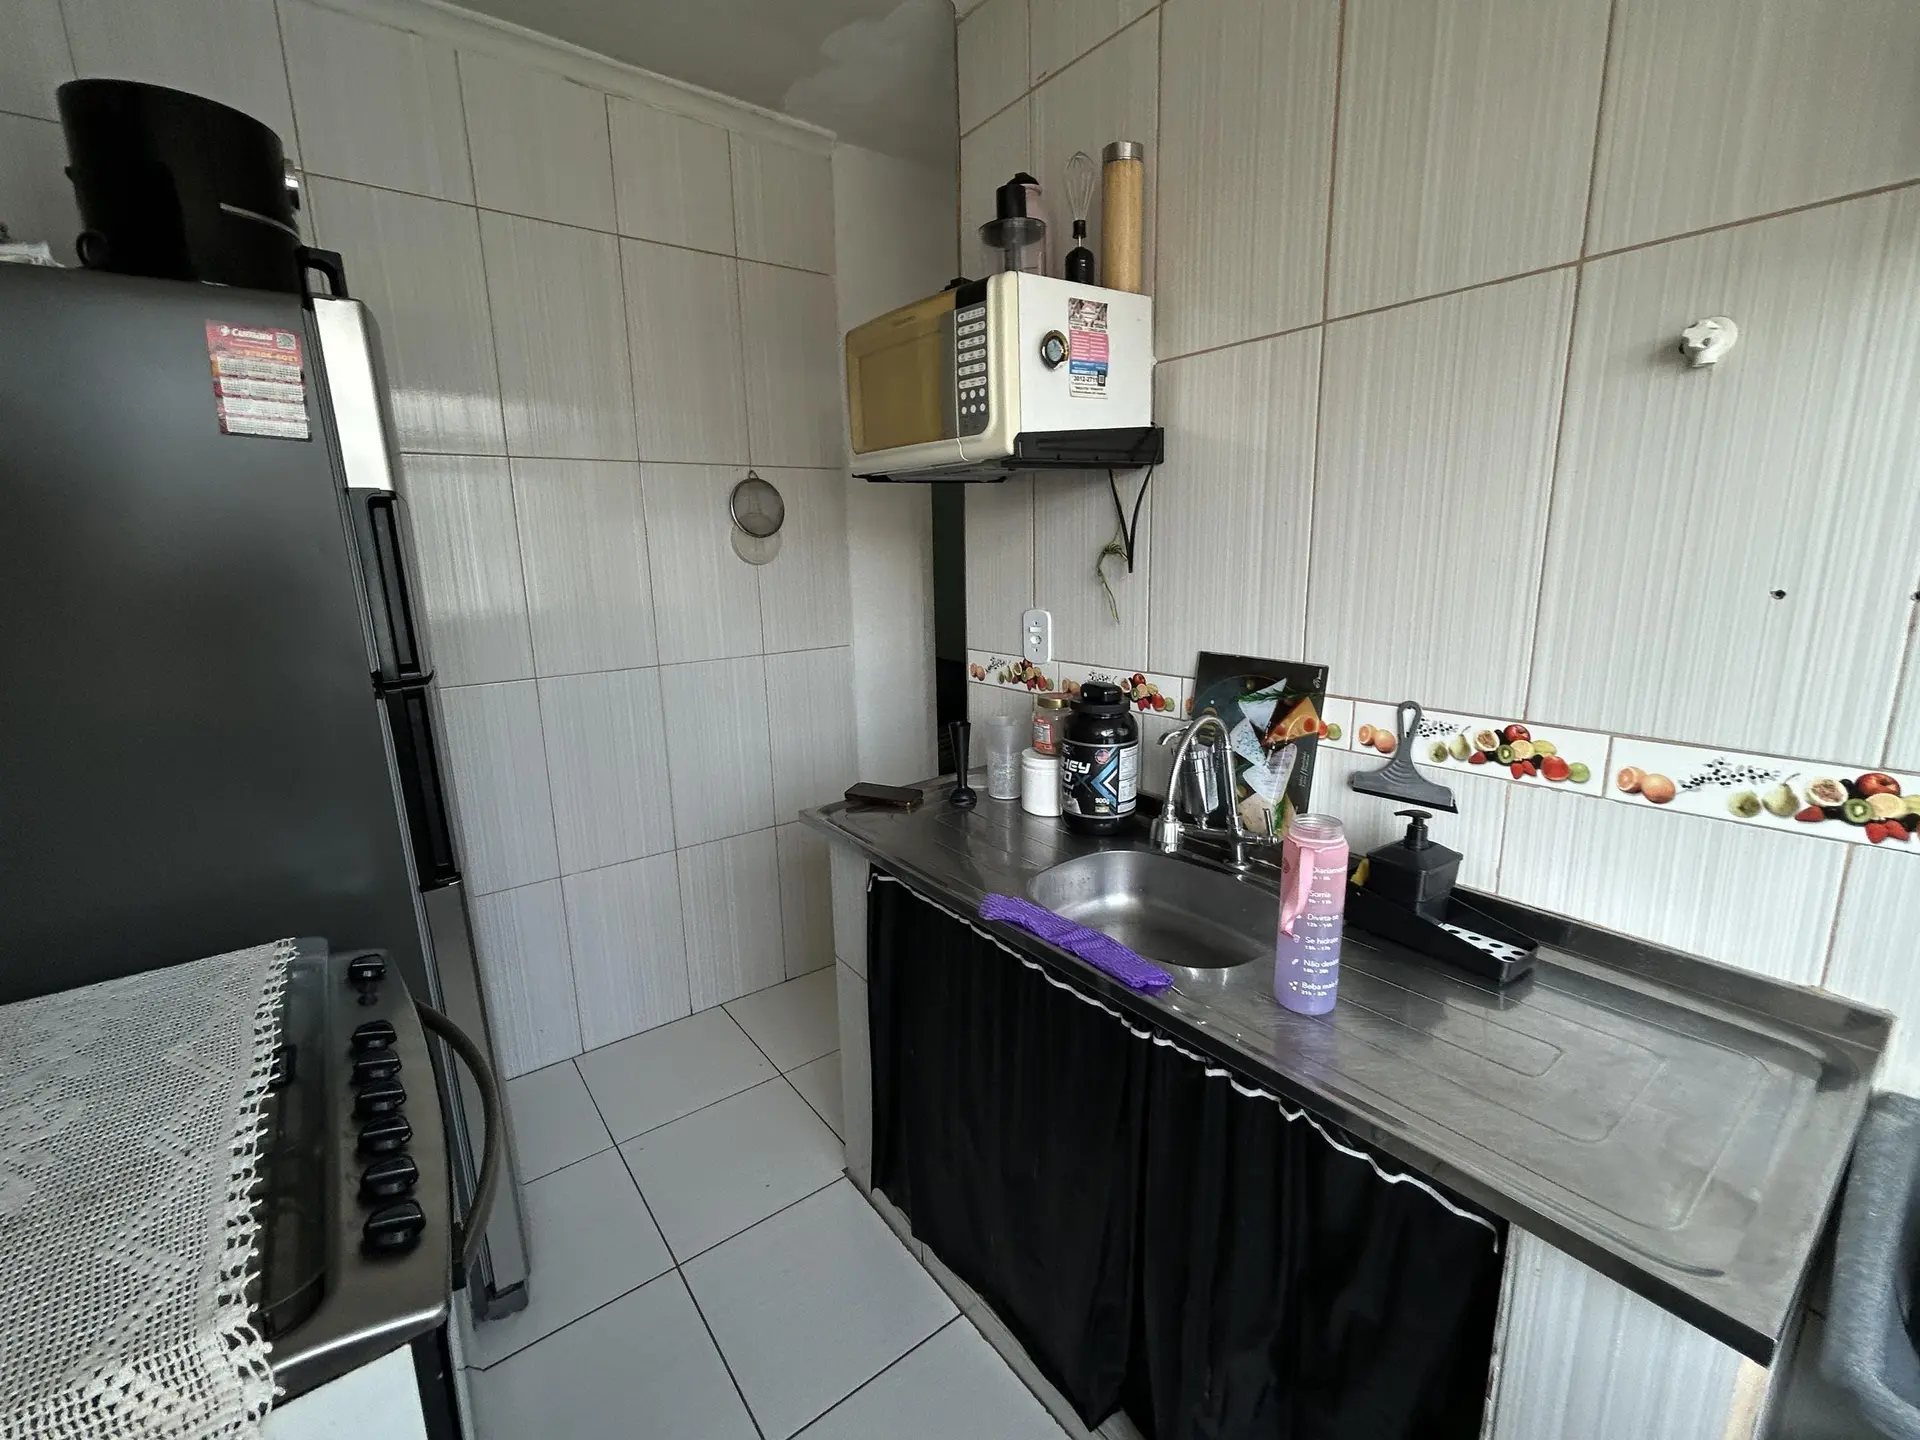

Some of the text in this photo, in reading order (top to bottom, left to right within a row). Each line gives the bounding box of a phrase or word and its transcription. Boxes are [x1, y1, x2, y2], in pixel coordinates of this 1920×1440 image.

[1305, 936, 1315, 944] Se
[1303, 958, 1320, 968] Não
[1301, 981, 1321, 990] Beba
